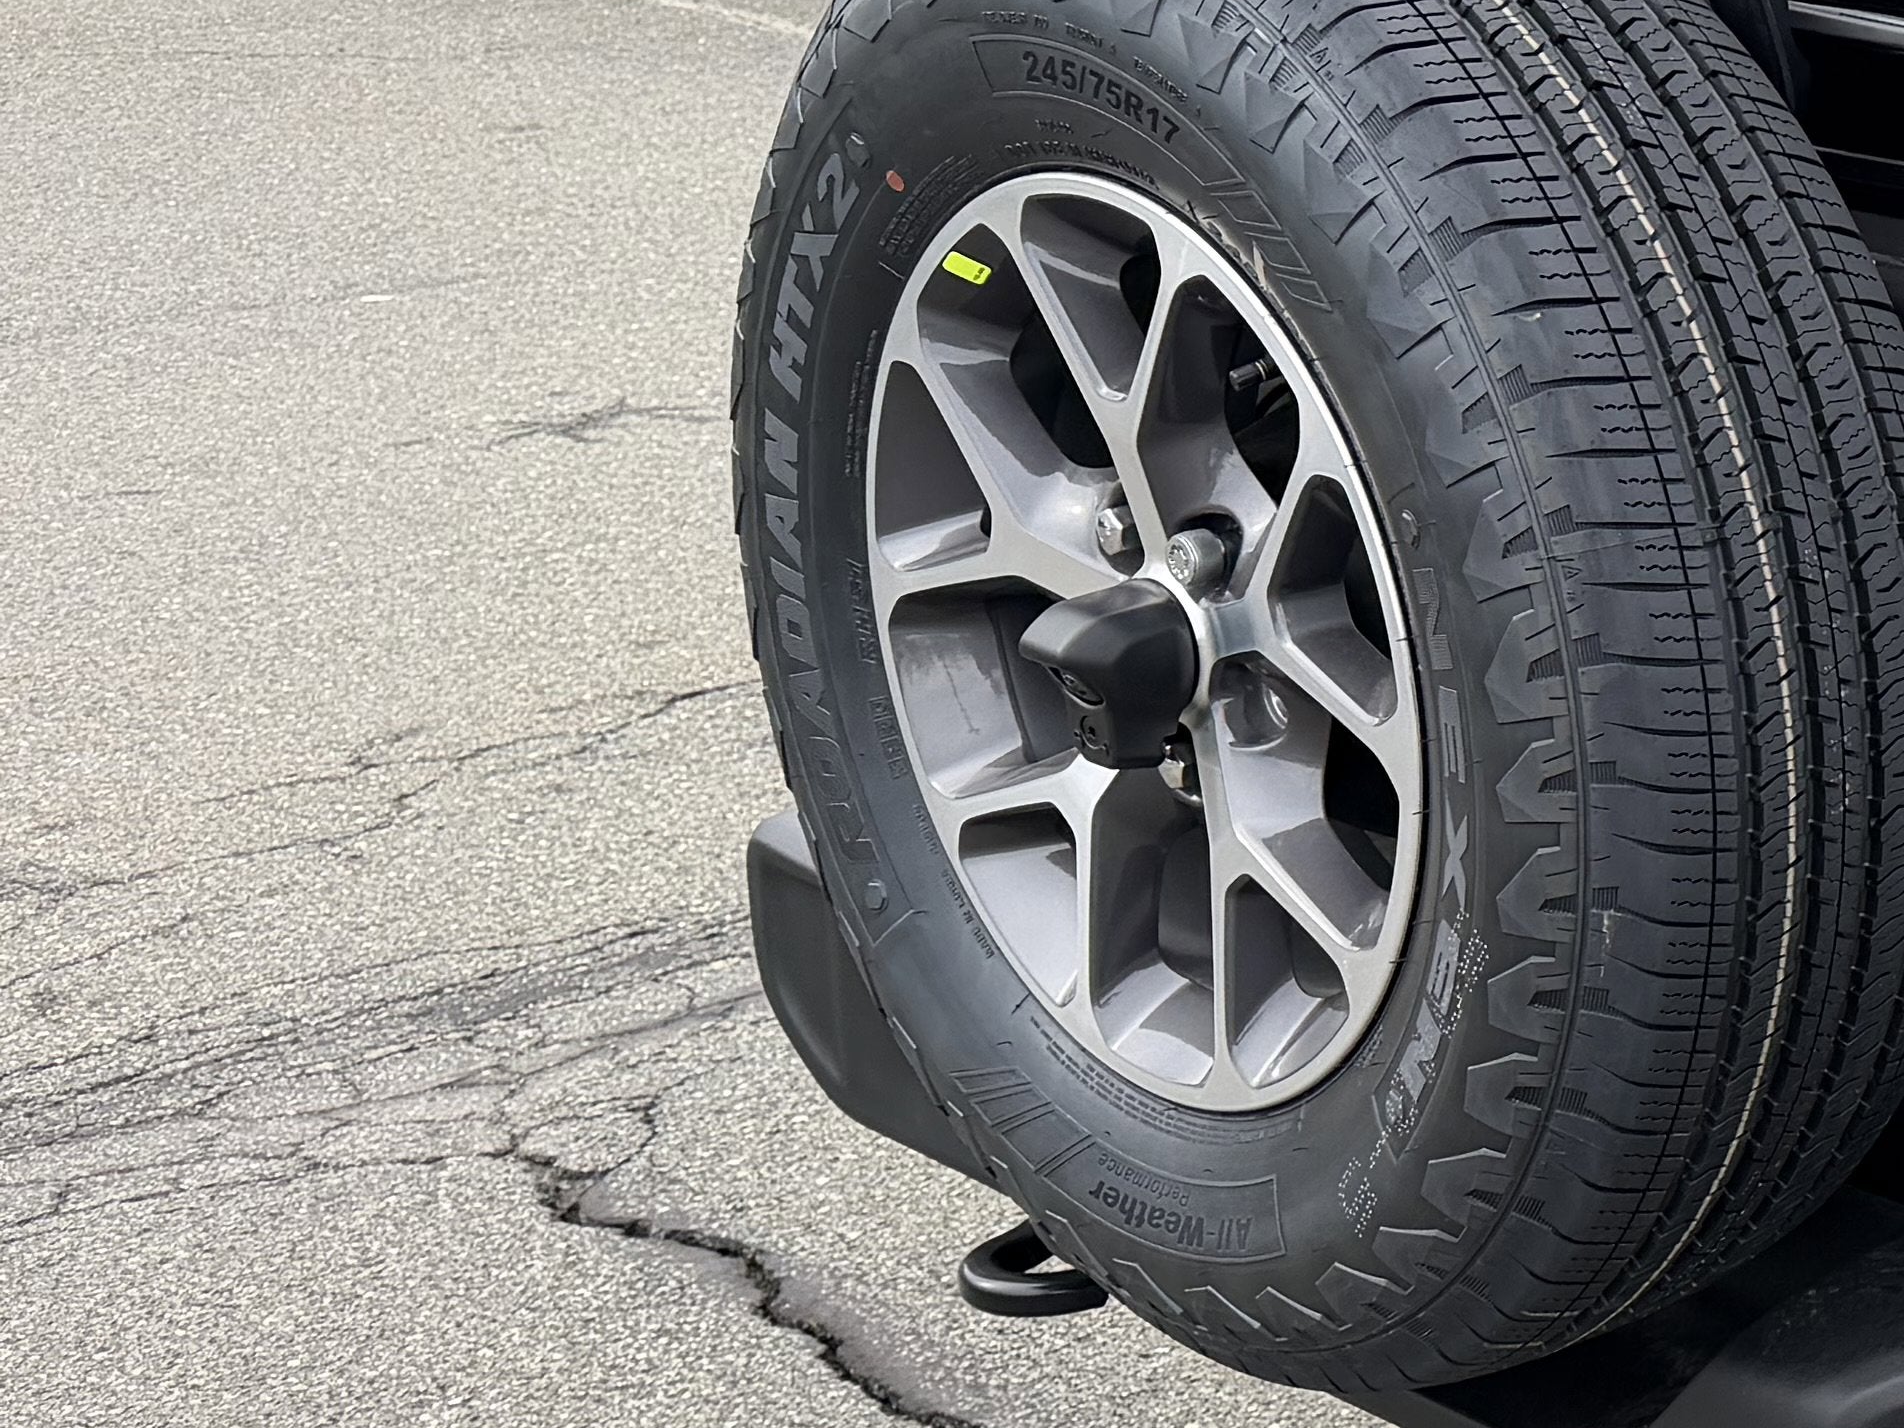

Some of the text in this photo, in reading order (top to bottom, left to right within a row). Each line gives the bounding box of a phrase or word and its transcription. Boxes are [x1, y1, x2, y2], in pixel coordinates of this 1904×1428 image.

[1021, 50, 1180, 144] 245/75R17
[763, 152, 880, 864] ROADIAN HTX2
[1399, 567, 1468, 1103] NEXEN
[1088, 1179, 1254, 1252] All-Weather
[1098, 1152, 1190, 1207] Performance
